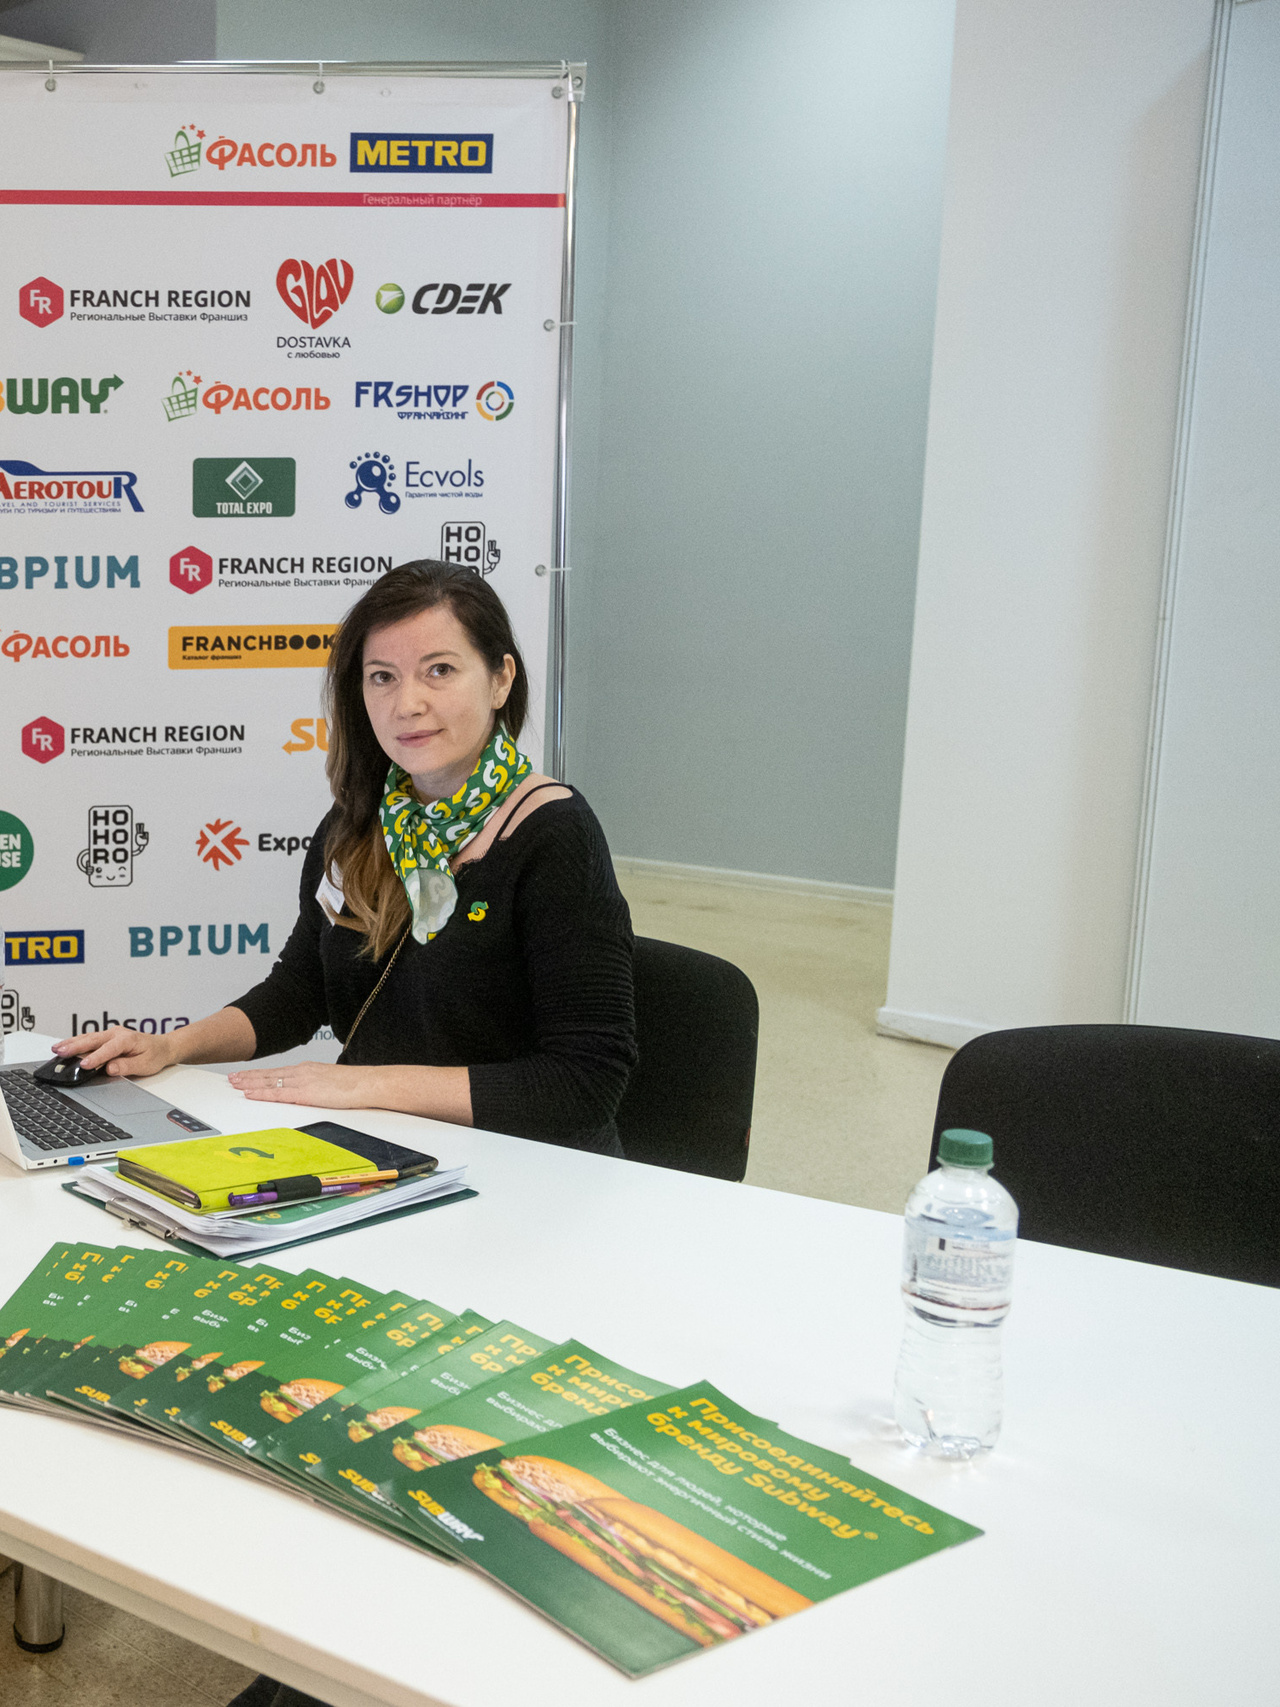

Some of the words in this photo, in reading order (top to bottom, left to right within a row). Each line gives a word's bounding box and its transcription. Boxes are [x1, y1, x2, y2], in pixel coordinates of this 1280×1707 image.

[206, 136, 337, 170] ФАСОЛЬ
[357, 140, 487, 167] METRO
[363, 193, 435, 205] Генеральный
[70, 289, 159, 307] FRANCH
[167, 290, 251, 307] REGION
[412, 282, 512, 315] CDEK
[70, 311, 145, 322] Региональные
[148, 311, 197, 321] Выставки
[200, 311, 248, 323] Франшиз
[276, 336, 351, 349] DOSTAVKA
[295, 349, 340, 359] любовью
[202, 381, 331, 414] ФАСОЛЬ
[405, 459, 484, 488] Ecvols
[216, 502, 245, 515] TOTAL
[247, 502, 272, 515] EXPO
[445, 526, 481, 543] HO
[219, 557, 304, 574] FRANCH
[312, 556, 392, 573] REGION
[218, 578, 291, 588] Региональные
[293, 577, 340, 588] Выставки
[1, 630, 130, 663] ФАСОЛЬ
[70, 726, 157, 743] FRANCH
[164, 725, 245, 741] REGION
[70, 748, 143, 757] Региональные
[145, 746, 193, 756] Выставки
[195, 746, 242, 756] Франшиз
[92, 810, 129, 826] HO
[92, 829, 129, 845] HO
[129, 923, 270, 958] BPIUM
[646, 1411, 745, 1476] бренду
[667, 1405, 688, 1420] к
[688, 1419, 831, 1501] мировому
[689, 1397, 936, 1535] Присоединяйтесь
[589, 1432, 655, 1479] выбирают
[653, 1476, 738, 1527] энергичный
[604, 1427, 651, 1462] Бизнес
[649, 1456, 675, 1479] для
[724, 1502, 788, 1543] которые
